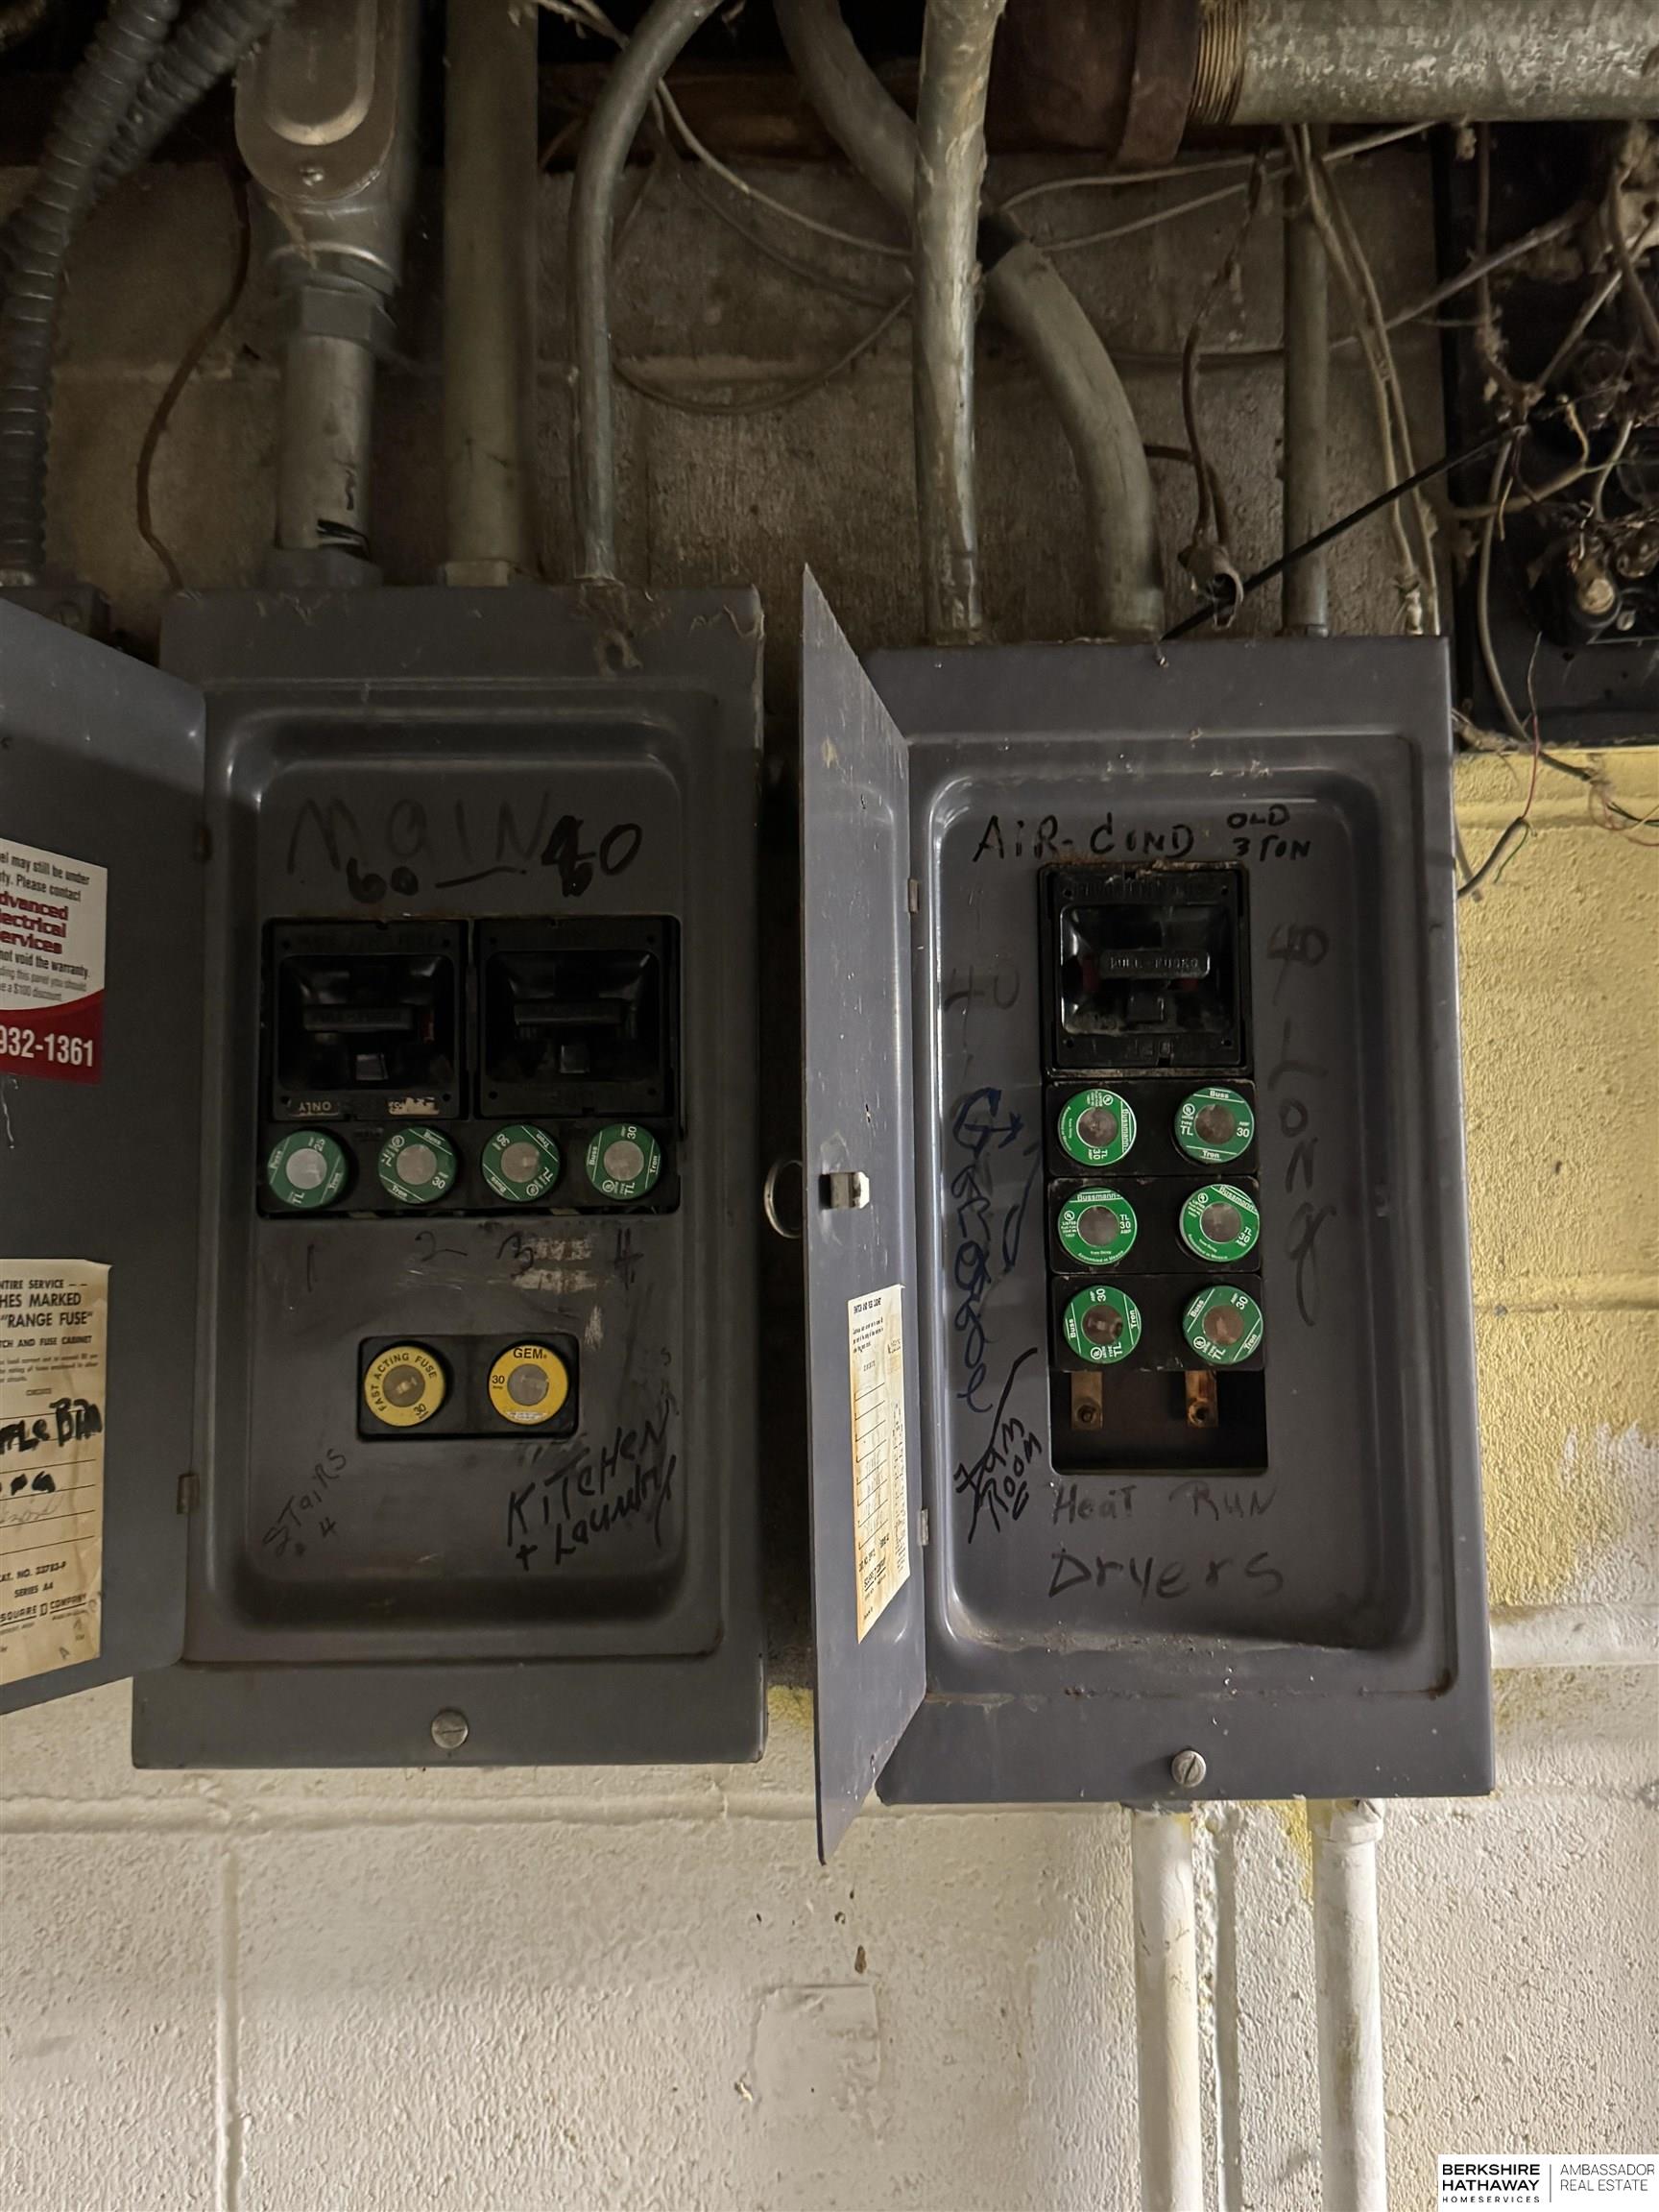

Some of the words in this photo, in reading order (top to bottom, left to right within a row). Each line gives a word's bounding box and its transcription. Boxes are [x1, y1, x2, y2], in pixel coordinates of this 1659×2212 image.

[1227, 804, 1290, 830] OLD
[17, 874, 46, 893] Please
[1210, 1090, 1230, 1099] Buss
[299, 1101, 332, 1113] ONLY
[626, 1125, 637, 1140] 30
[1180, 1125, 1194, 1137] TL
[1236, 1127, 1250, 1138] 30
[496, 1133, 511, 1147] 30
[1202, 1150, 1220, 1160] Tron
[432, 1176, 445, 1190] 30
[1119, 1214, 1131, 1222] TL
[1119, 1221, 1132, 1230] 30
[1238, 1232, 1251, 1244] 30
[29, 1279, 64, 1289] SERVICE
[0, 1293, 22, 1308] HES
[29, 1292, 82, 1308] MARKED
[1095, 1287, 1107, 1303] 30
[1236, 1296, 1250, 1310] 30
[1113, 1341, 1123, 1358] TL
[1212, 1348, 1227, 1360] TL
[375, 1352, 410, 1381] ACTING
[414, 1355, 438, 1380] FUSE
[492, 1375, 505, 1384] 30
[371, 1382, 387, 1411] FAST
[413, 1403, 427, 1416] 30
[14, 1585, 38, 1598] SERIES
[0, 1605, 36, 1623] SQUARE
[39, 1602, 48, 1617] D
[49, 1594, 86, 1609] COMPANY
